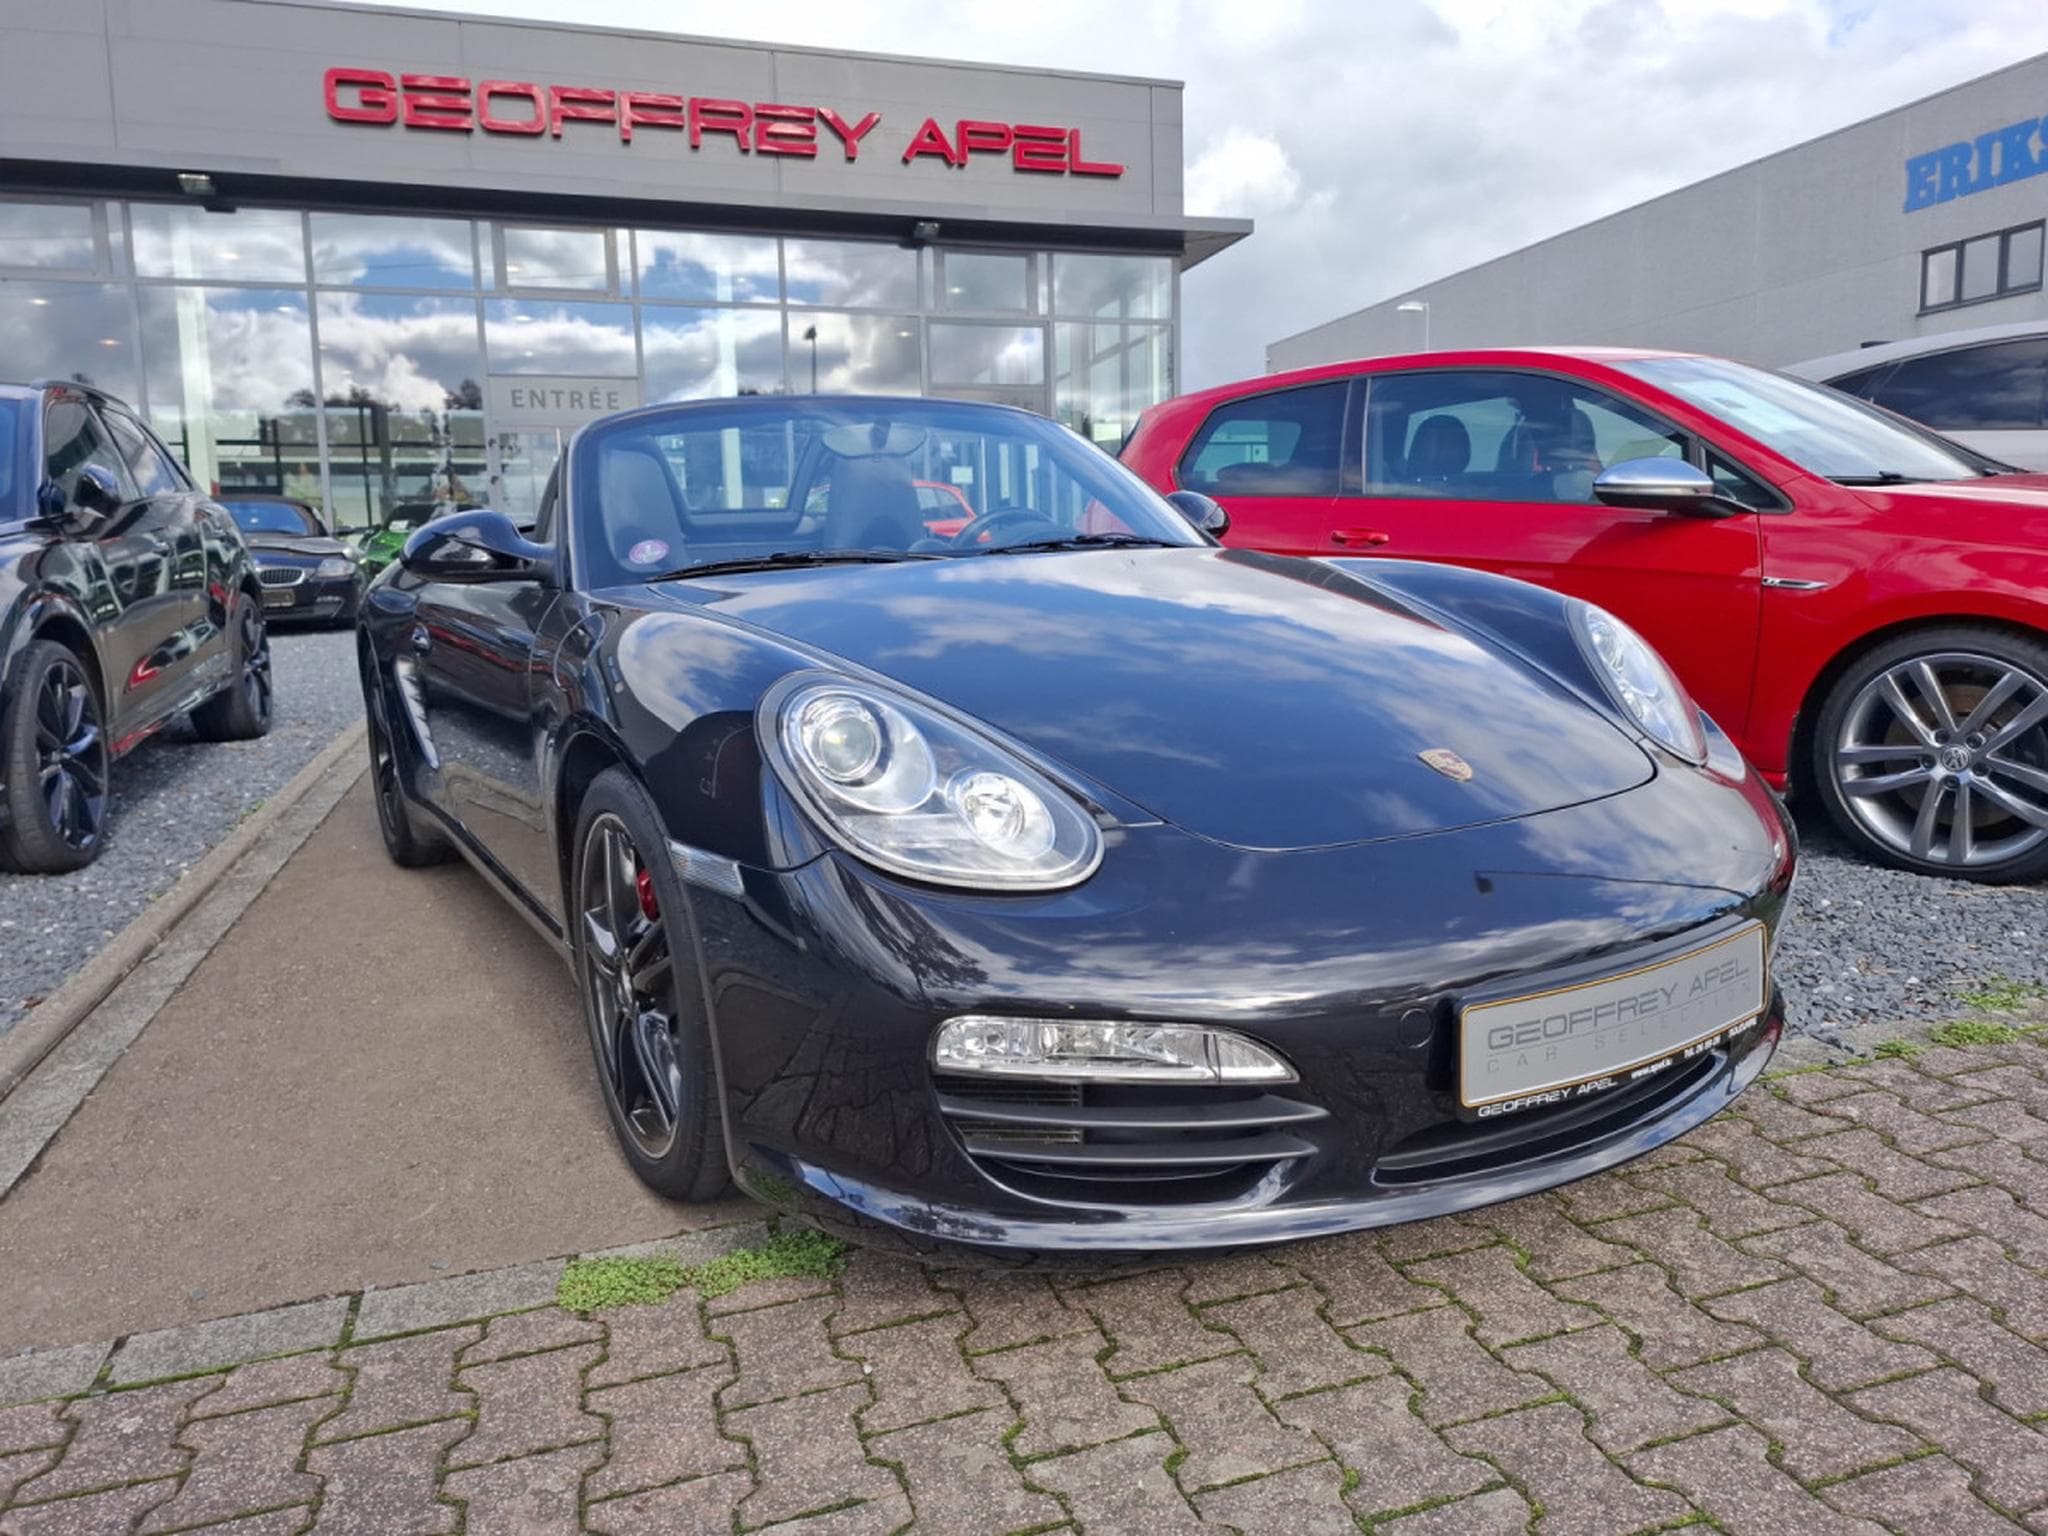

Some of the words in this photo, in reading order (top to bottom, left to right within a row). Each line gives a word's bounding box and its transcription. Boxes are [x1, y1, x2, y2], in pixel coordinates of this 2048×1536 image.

[324, 67, 882, 161] GEOFFREY
[902, 117, 1126, 177] APEL
[511, 386, 620, 410] ENTRÉE
[1488, 982, 1678, 1050] GEOFFREY
[1689, 959, 1749, 997] APEL
[1478, 1088, 1571, 1117] GEOFFREY
[1577, 1077, 1618, 1096] APEL
